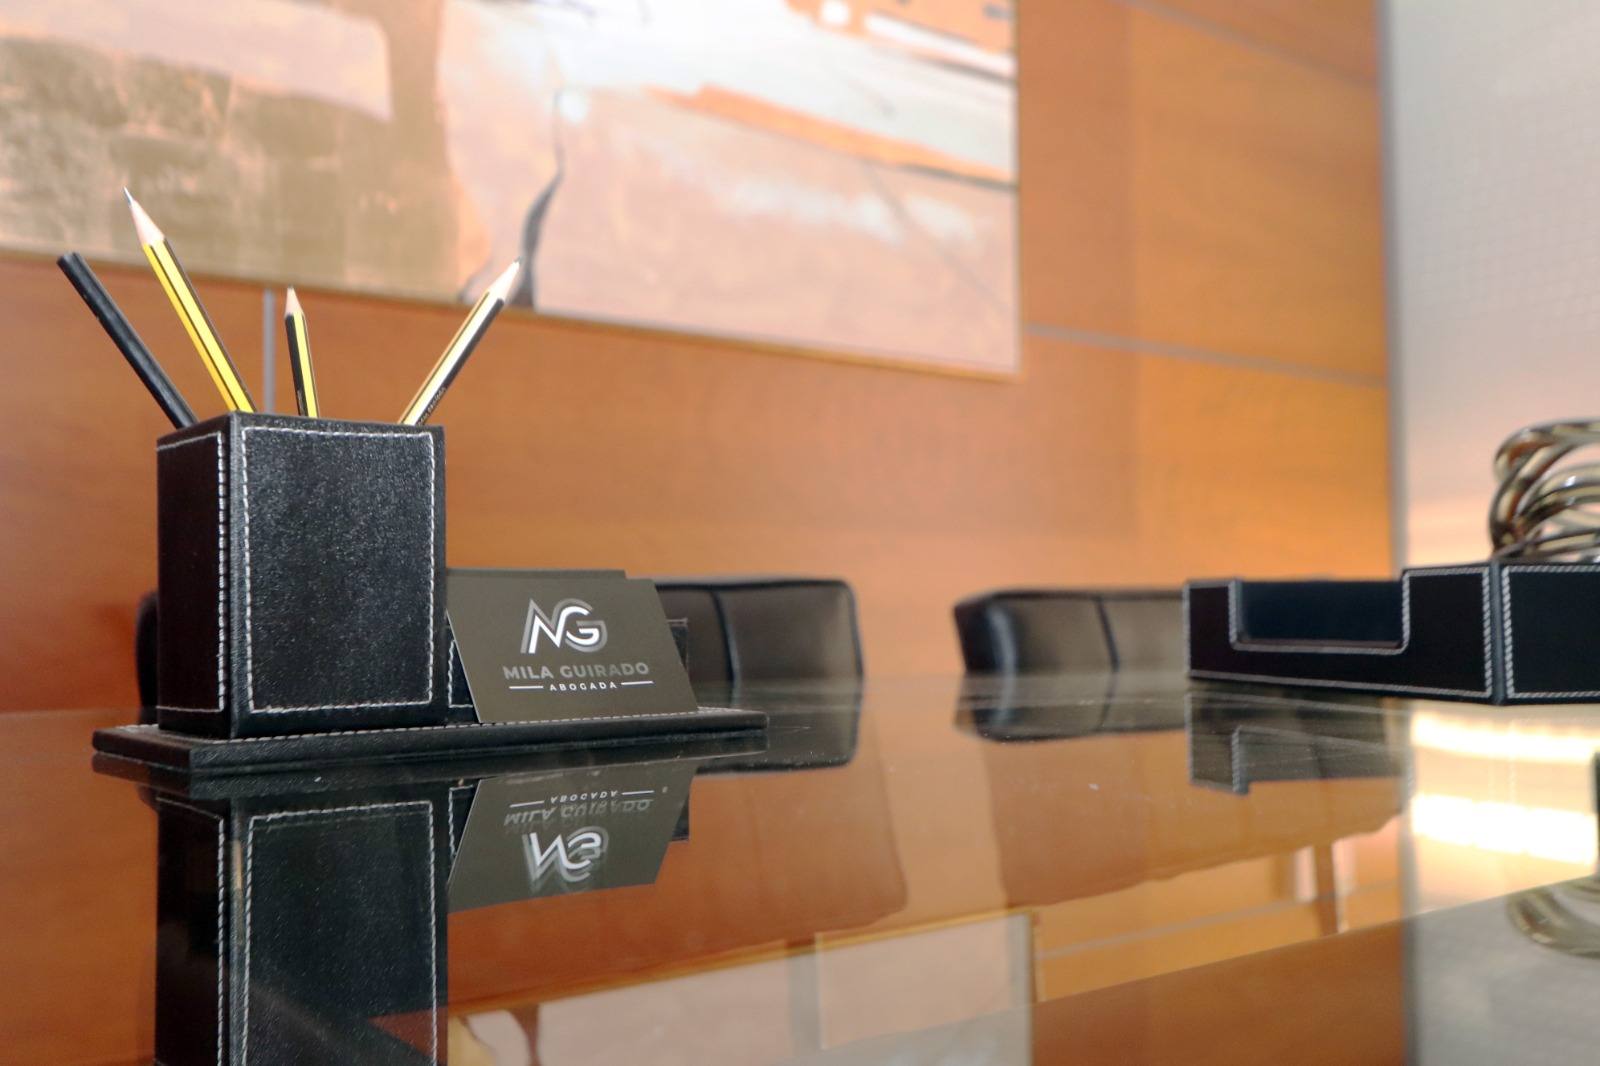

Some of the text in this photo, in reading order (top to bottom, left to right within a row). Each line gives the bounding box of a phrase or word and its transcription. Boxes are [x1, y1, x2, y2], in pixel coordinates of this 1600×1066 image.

[502, 662, 650, 680] MILA GUIRADO
[550, 681, 617, 691] ABOGADA
